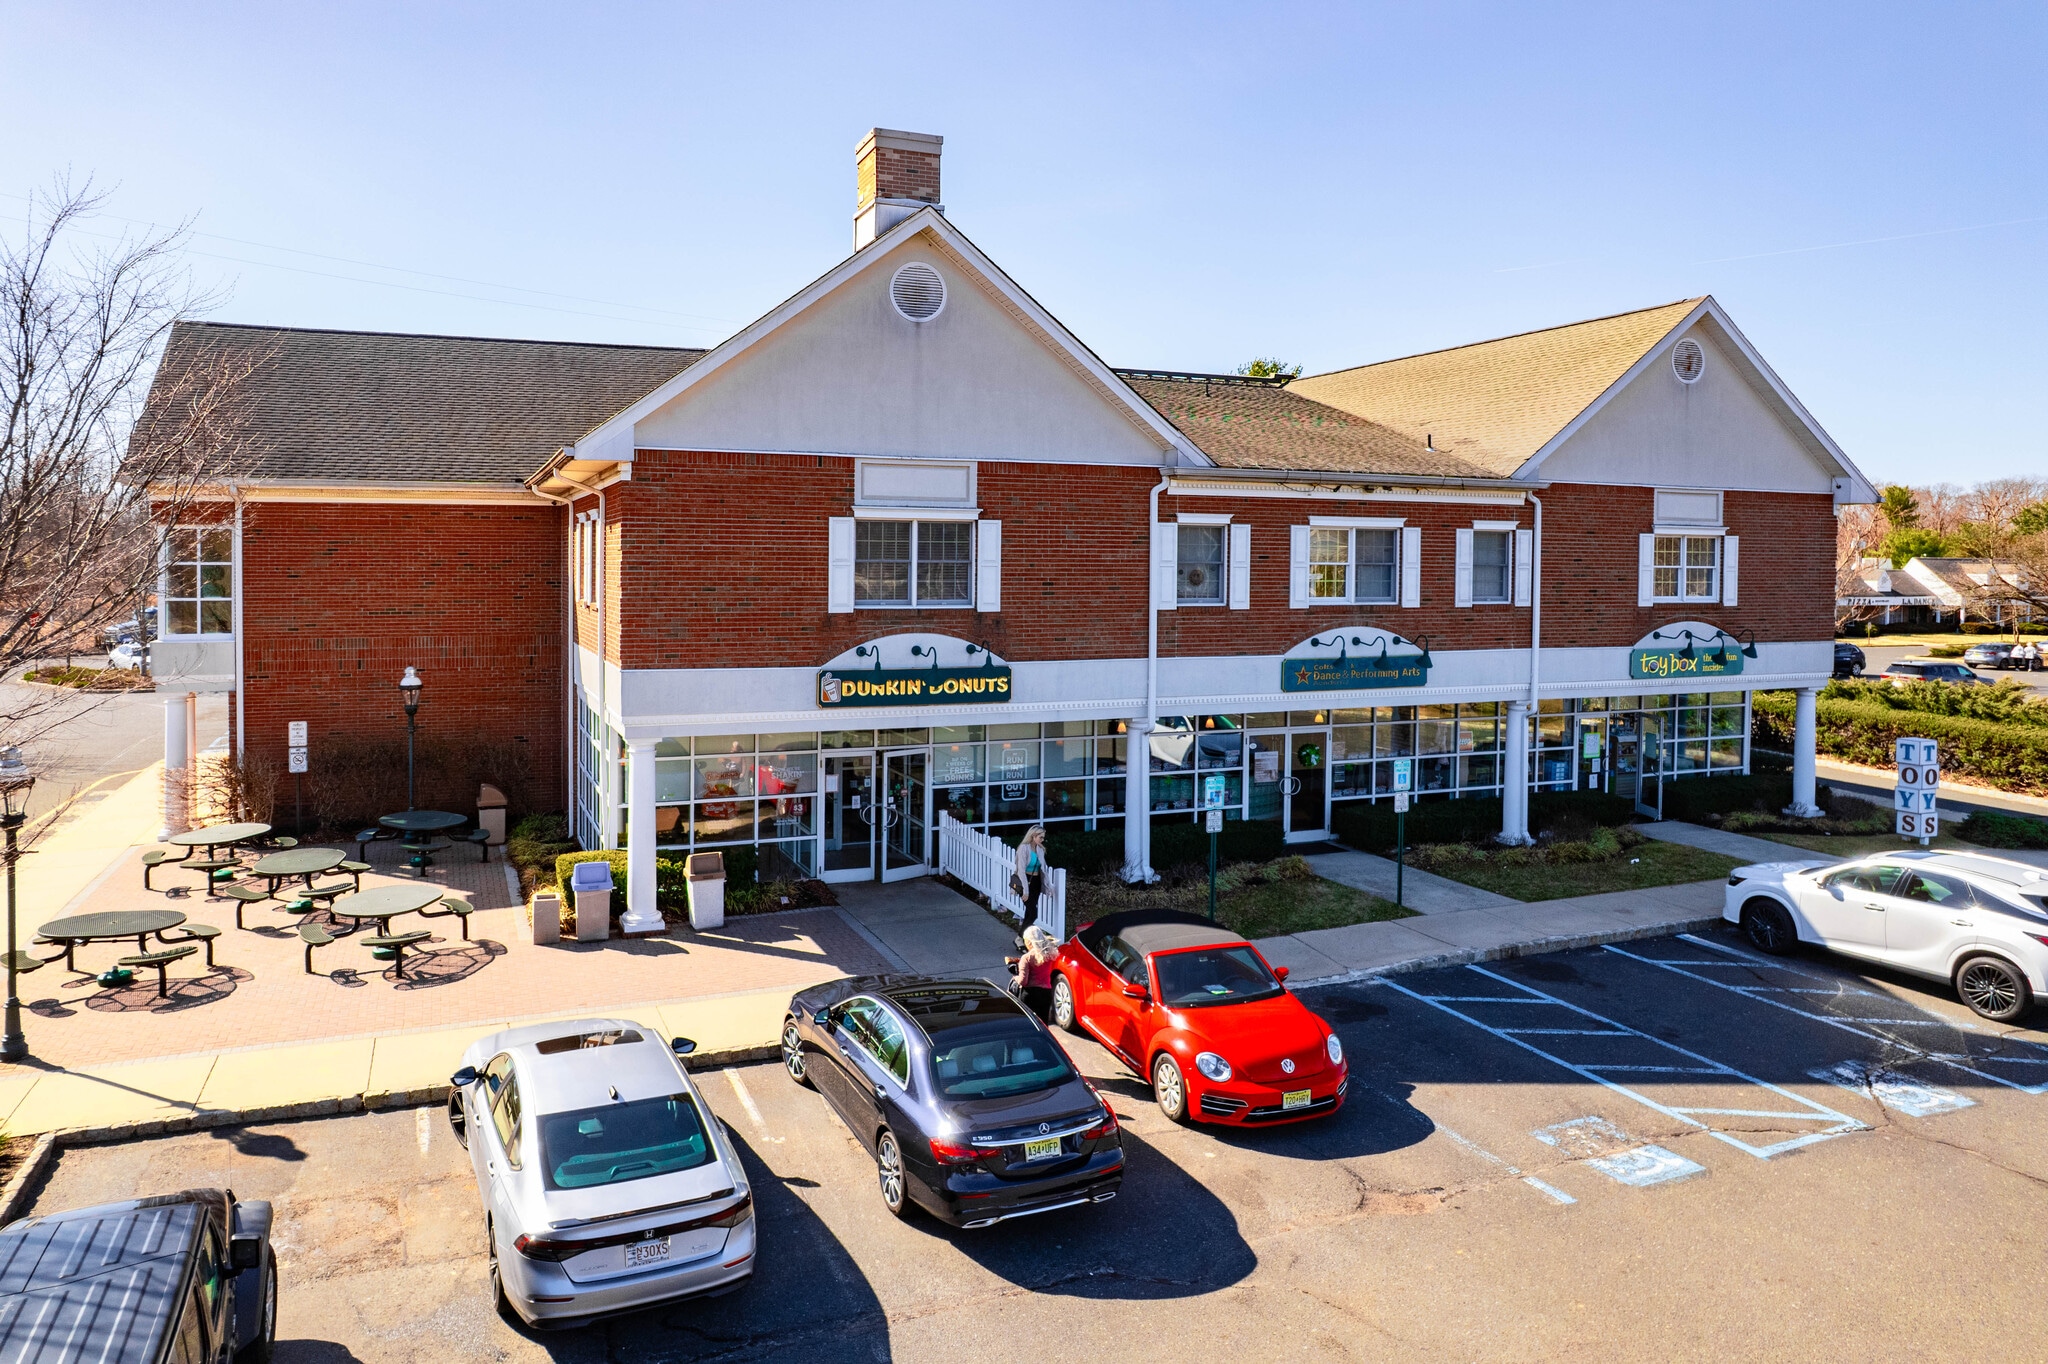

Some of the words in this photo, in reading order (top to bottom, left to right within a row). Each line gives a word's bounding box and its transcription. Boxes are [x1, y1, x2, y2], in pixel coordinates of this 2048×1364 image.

[1313, 671, 1341, 680] Dance
[1342, 670, 1349, 679] &
[1351, 669, 1399, 679] Performing
[1402, 667, 1421, 676] Arts
[929, 677, 1009, 695] DONUTS
[1006, 756, 1024, 764] RUN
[944, 773, 975, 782] DRINKS
[1005, 783, 1024, 791] OUT
[1898, 743, 1919, 833] TOYS
[1922, 745, 1938, 834] TOYS
